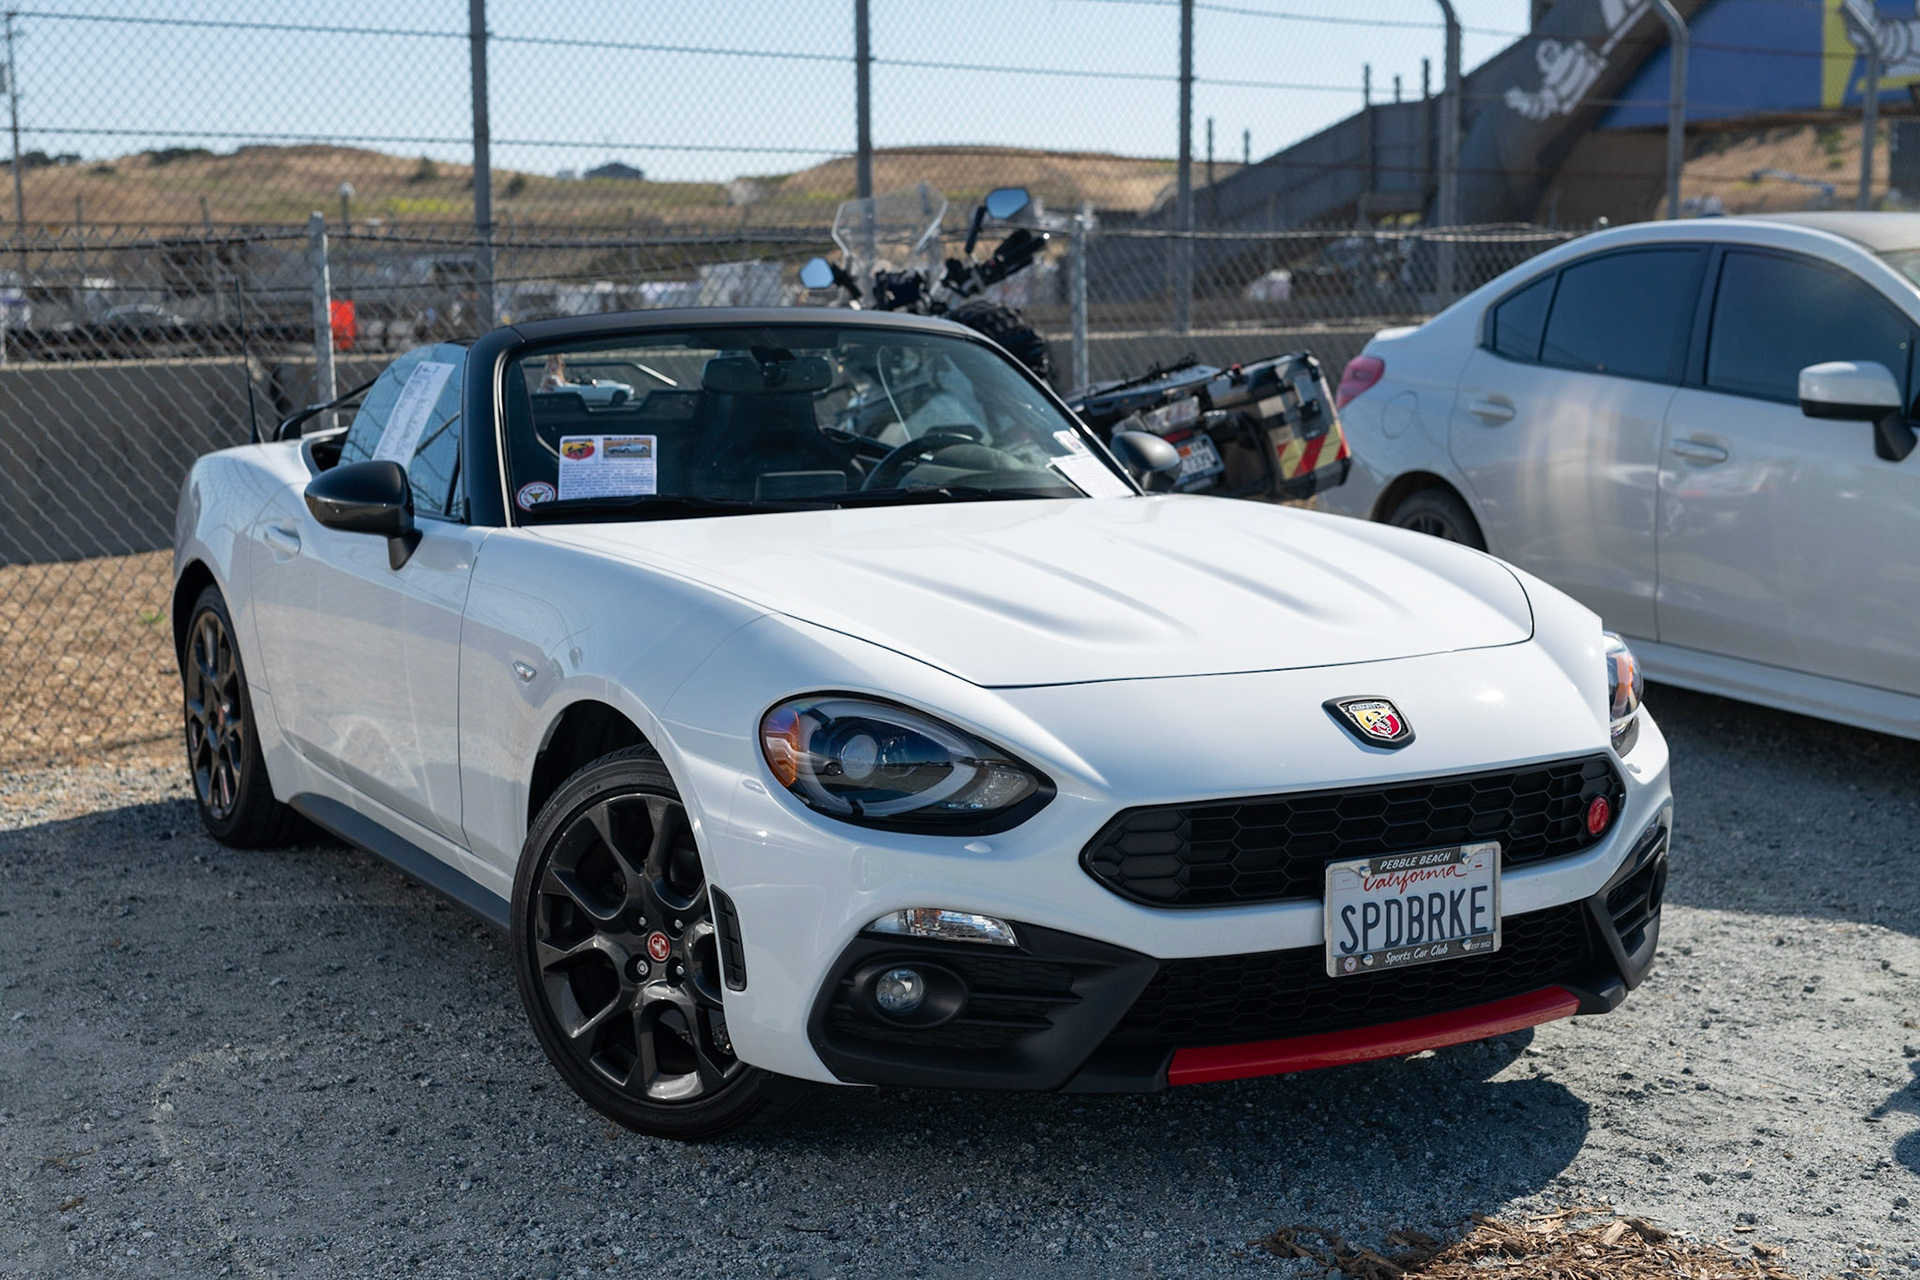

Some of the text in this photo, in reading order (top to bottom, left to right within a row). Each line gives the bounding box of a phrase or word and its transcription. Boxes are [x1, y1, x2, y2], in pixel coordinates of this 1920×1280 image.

[1379, 851, 1451, 870] PEBBLE BEACH
[1363, 864, 1467, 894] California
[1339, 885, 1488, 954] SPDBRKE
[1384, 951, 1411, 965] Sports
[1413, 947, 1428, 958] Car
[1431, 943, 1449, 957] Club
